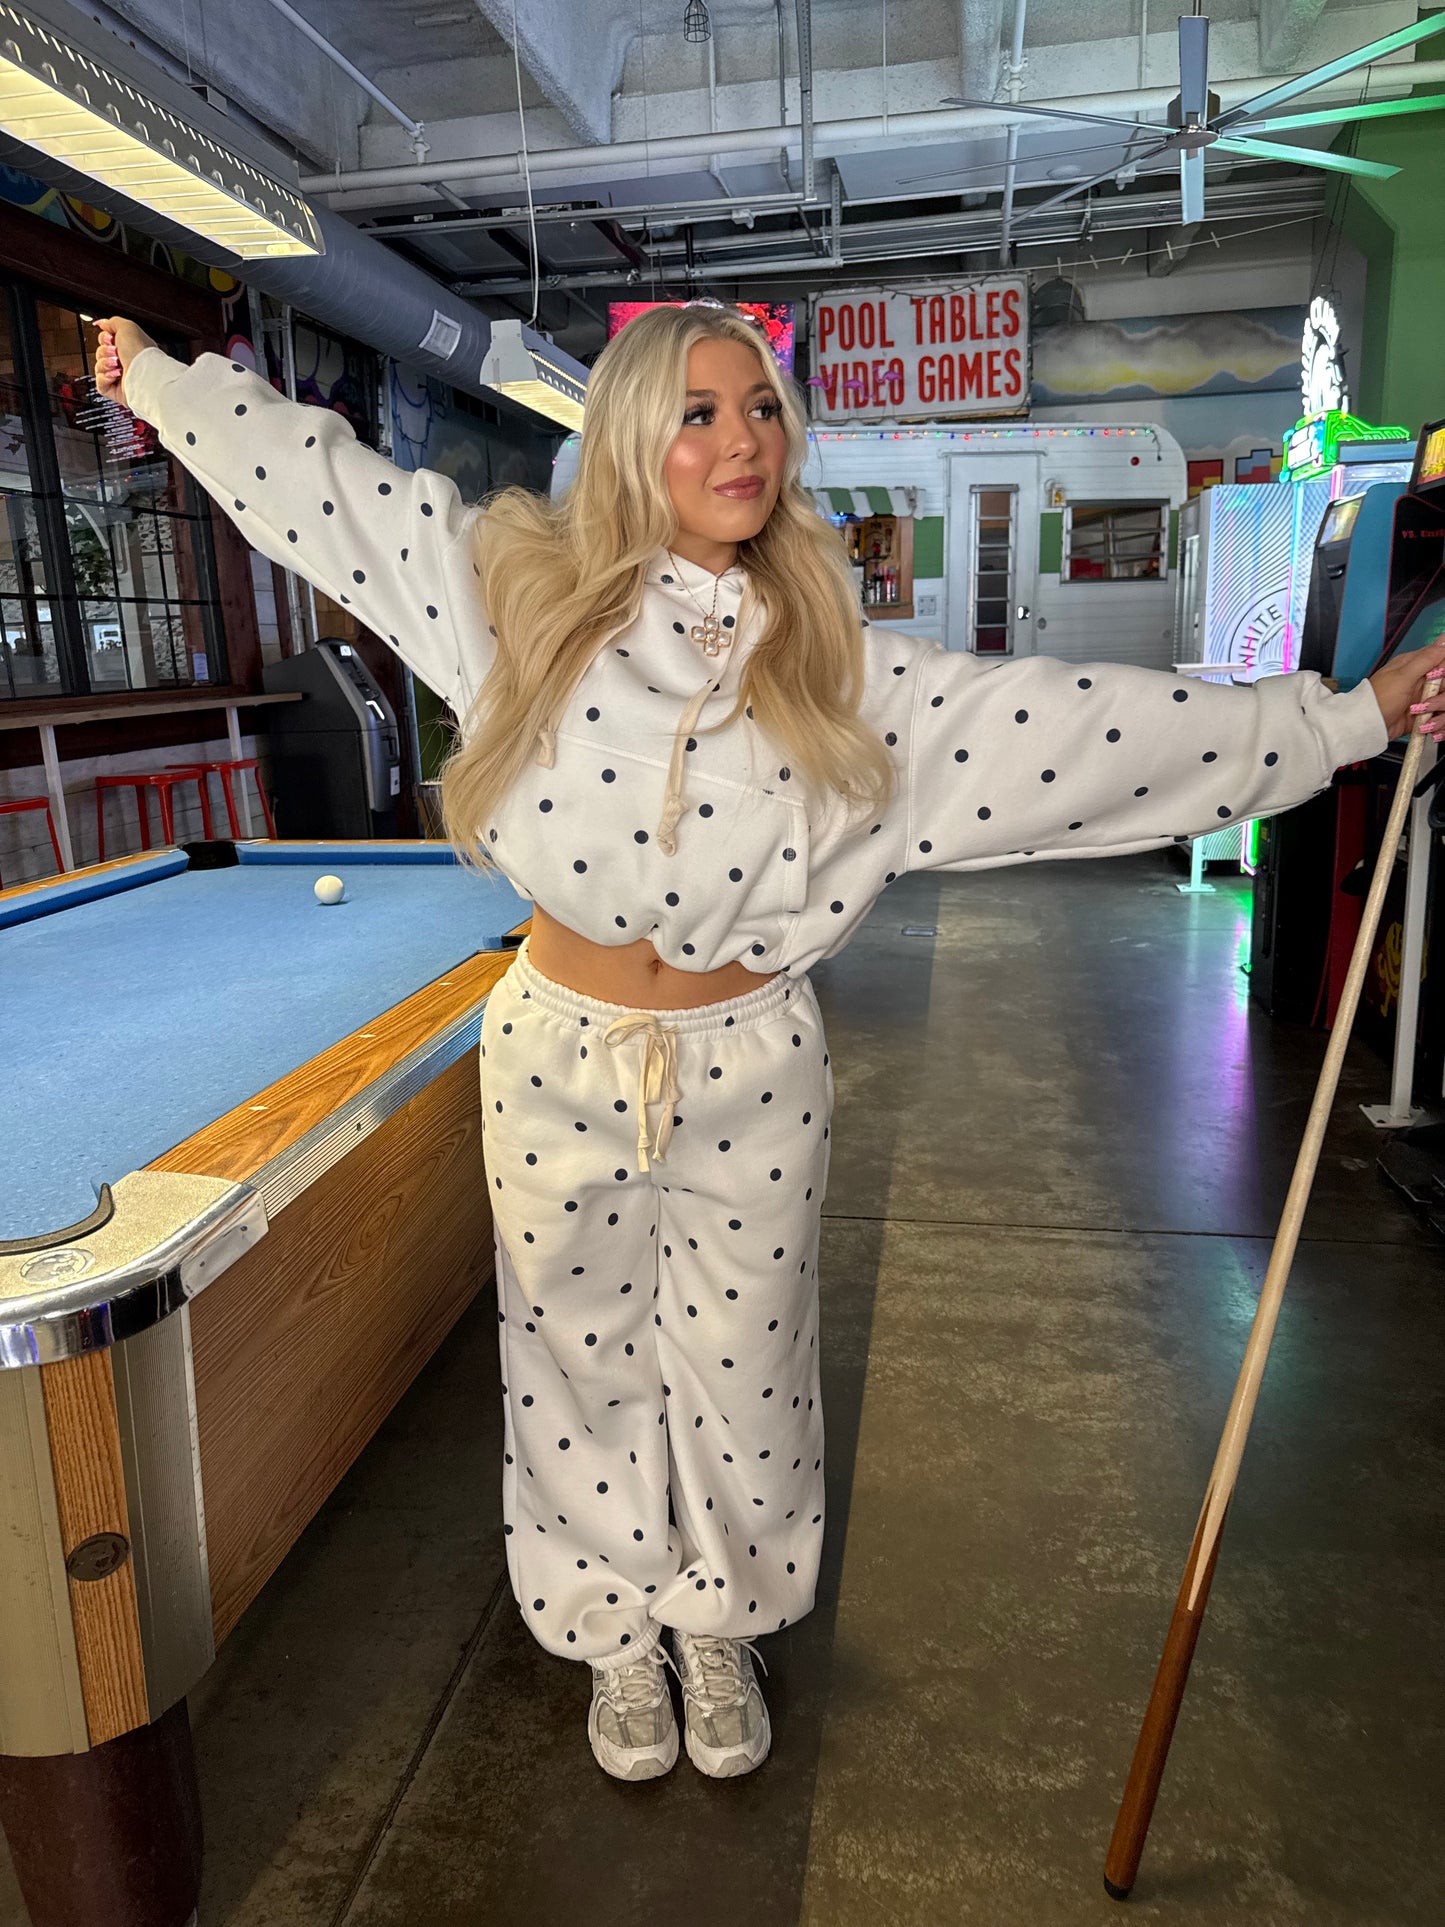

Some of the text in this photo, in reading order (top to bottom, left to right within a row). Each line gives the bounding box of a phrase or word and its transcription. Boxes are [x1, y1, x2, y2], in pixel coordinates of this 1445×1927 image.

[819, 289, 1020, 353] POOL TABLES
[820, 348, 1021, 411] VIDEO GAMES
[1238, 603, 1282, 669] WHITE
